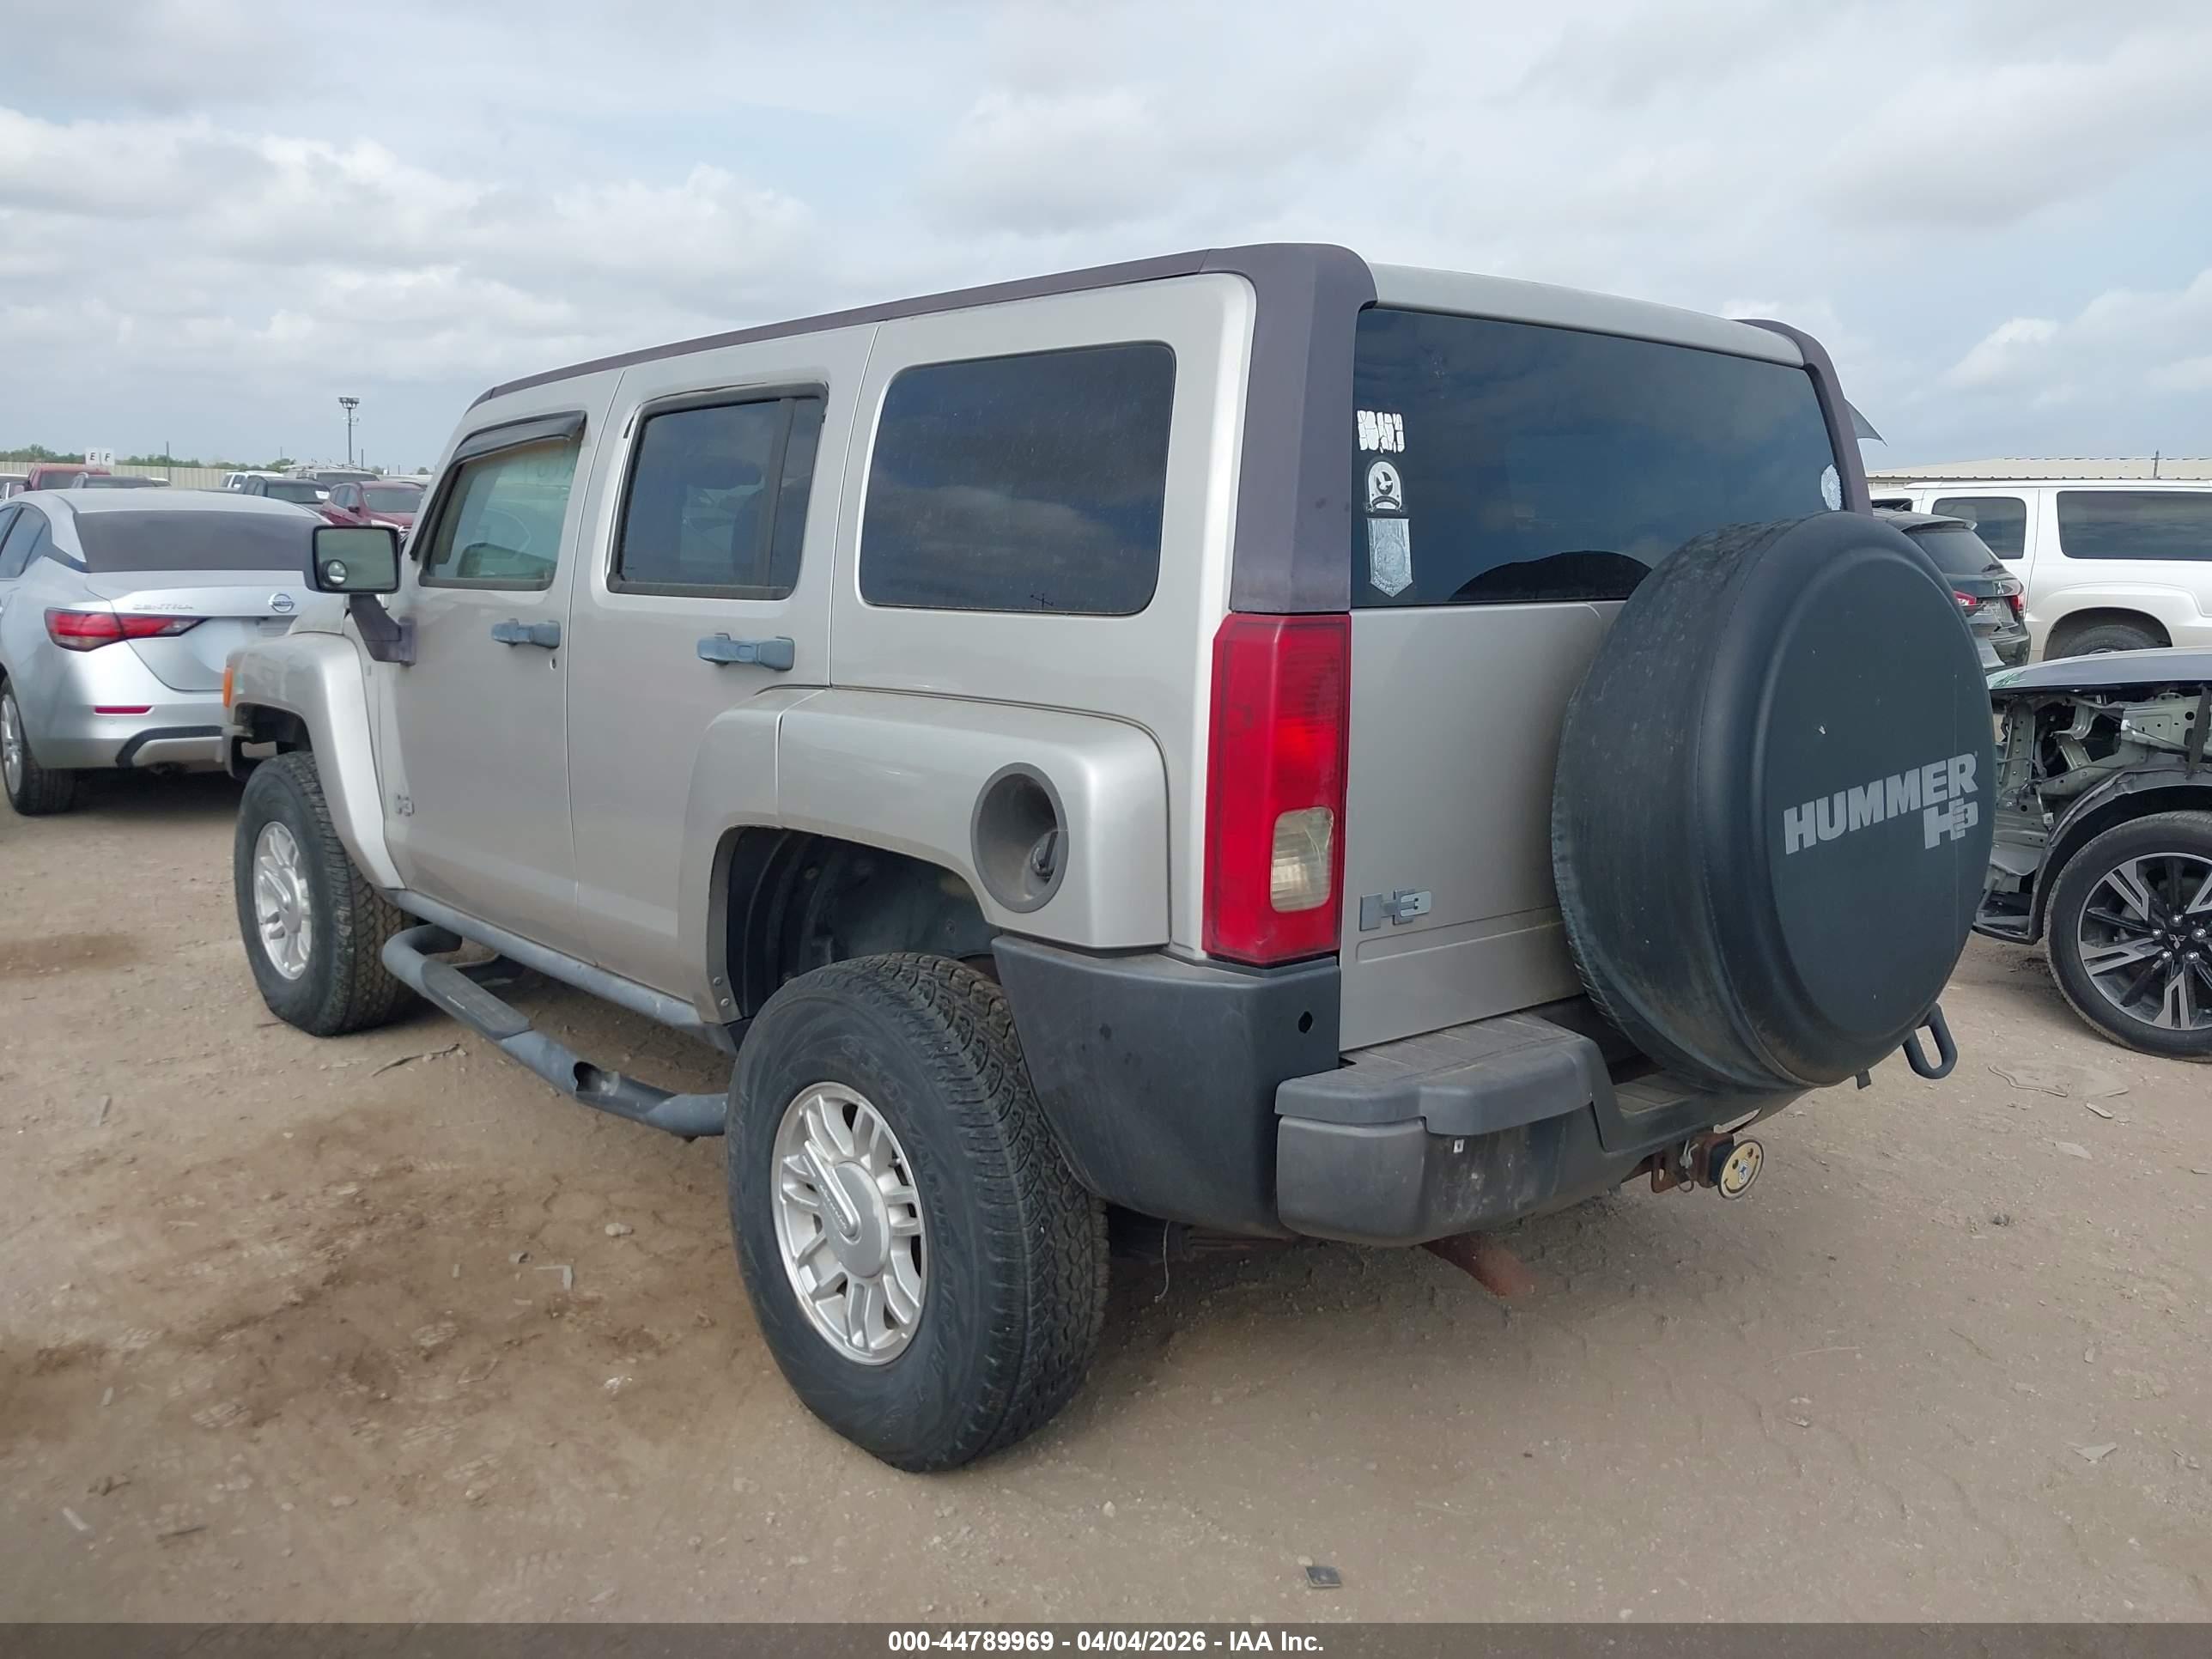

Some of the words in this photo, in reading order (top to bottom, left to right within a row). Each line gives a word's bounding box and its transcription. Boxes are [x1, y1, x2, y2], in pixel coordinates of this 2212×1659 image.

[89, 452, 96, 461] E
[104, 453, 111, 462] F
[1784, 752, 1978, 854] HUMMER
[1923, 798, 1978, 849] H3
[1359, 889, 1432, 932] H3
